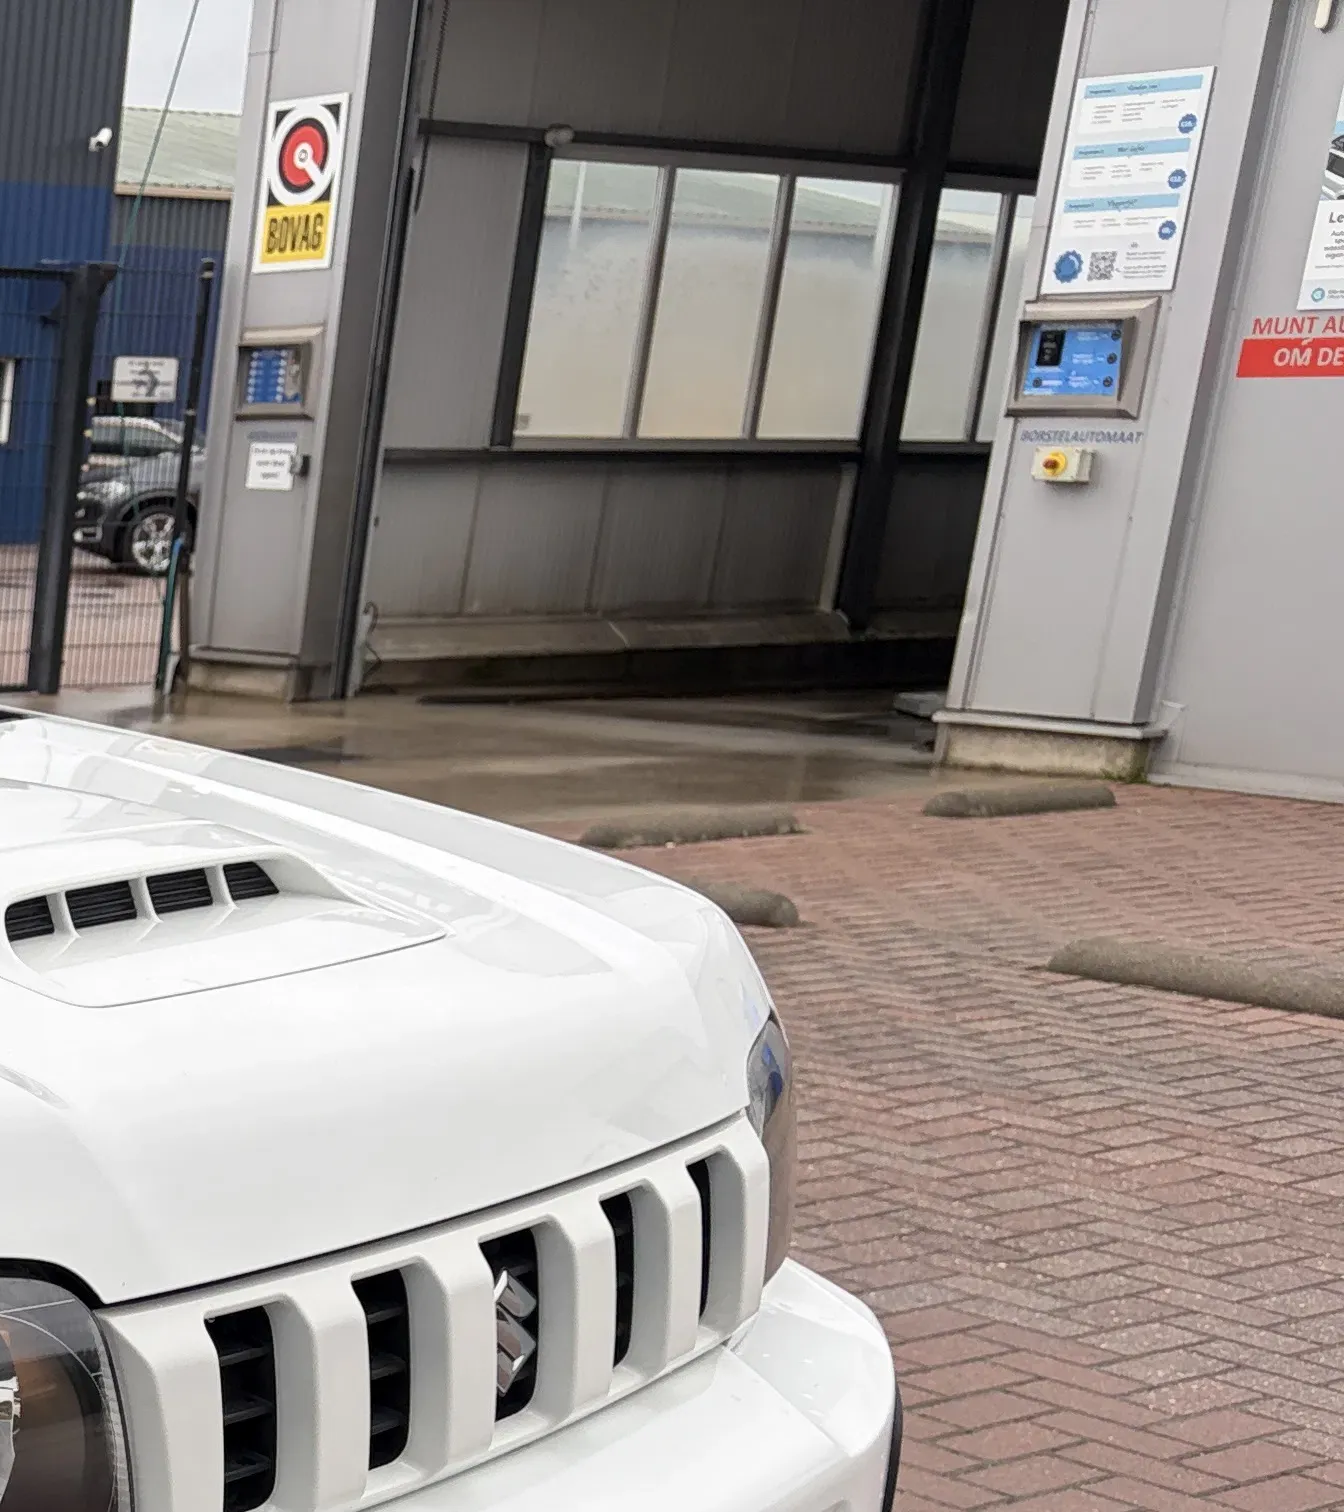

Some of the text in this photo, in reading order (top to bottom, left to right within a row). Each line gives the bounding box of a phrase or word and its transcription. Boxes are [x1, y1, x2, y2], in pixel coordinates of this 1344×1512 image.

[266, 212, 324, 254] BOVAG
[1252, 316, 1319, 335] MUNT
[1273, 347, 1312, 368] OM
